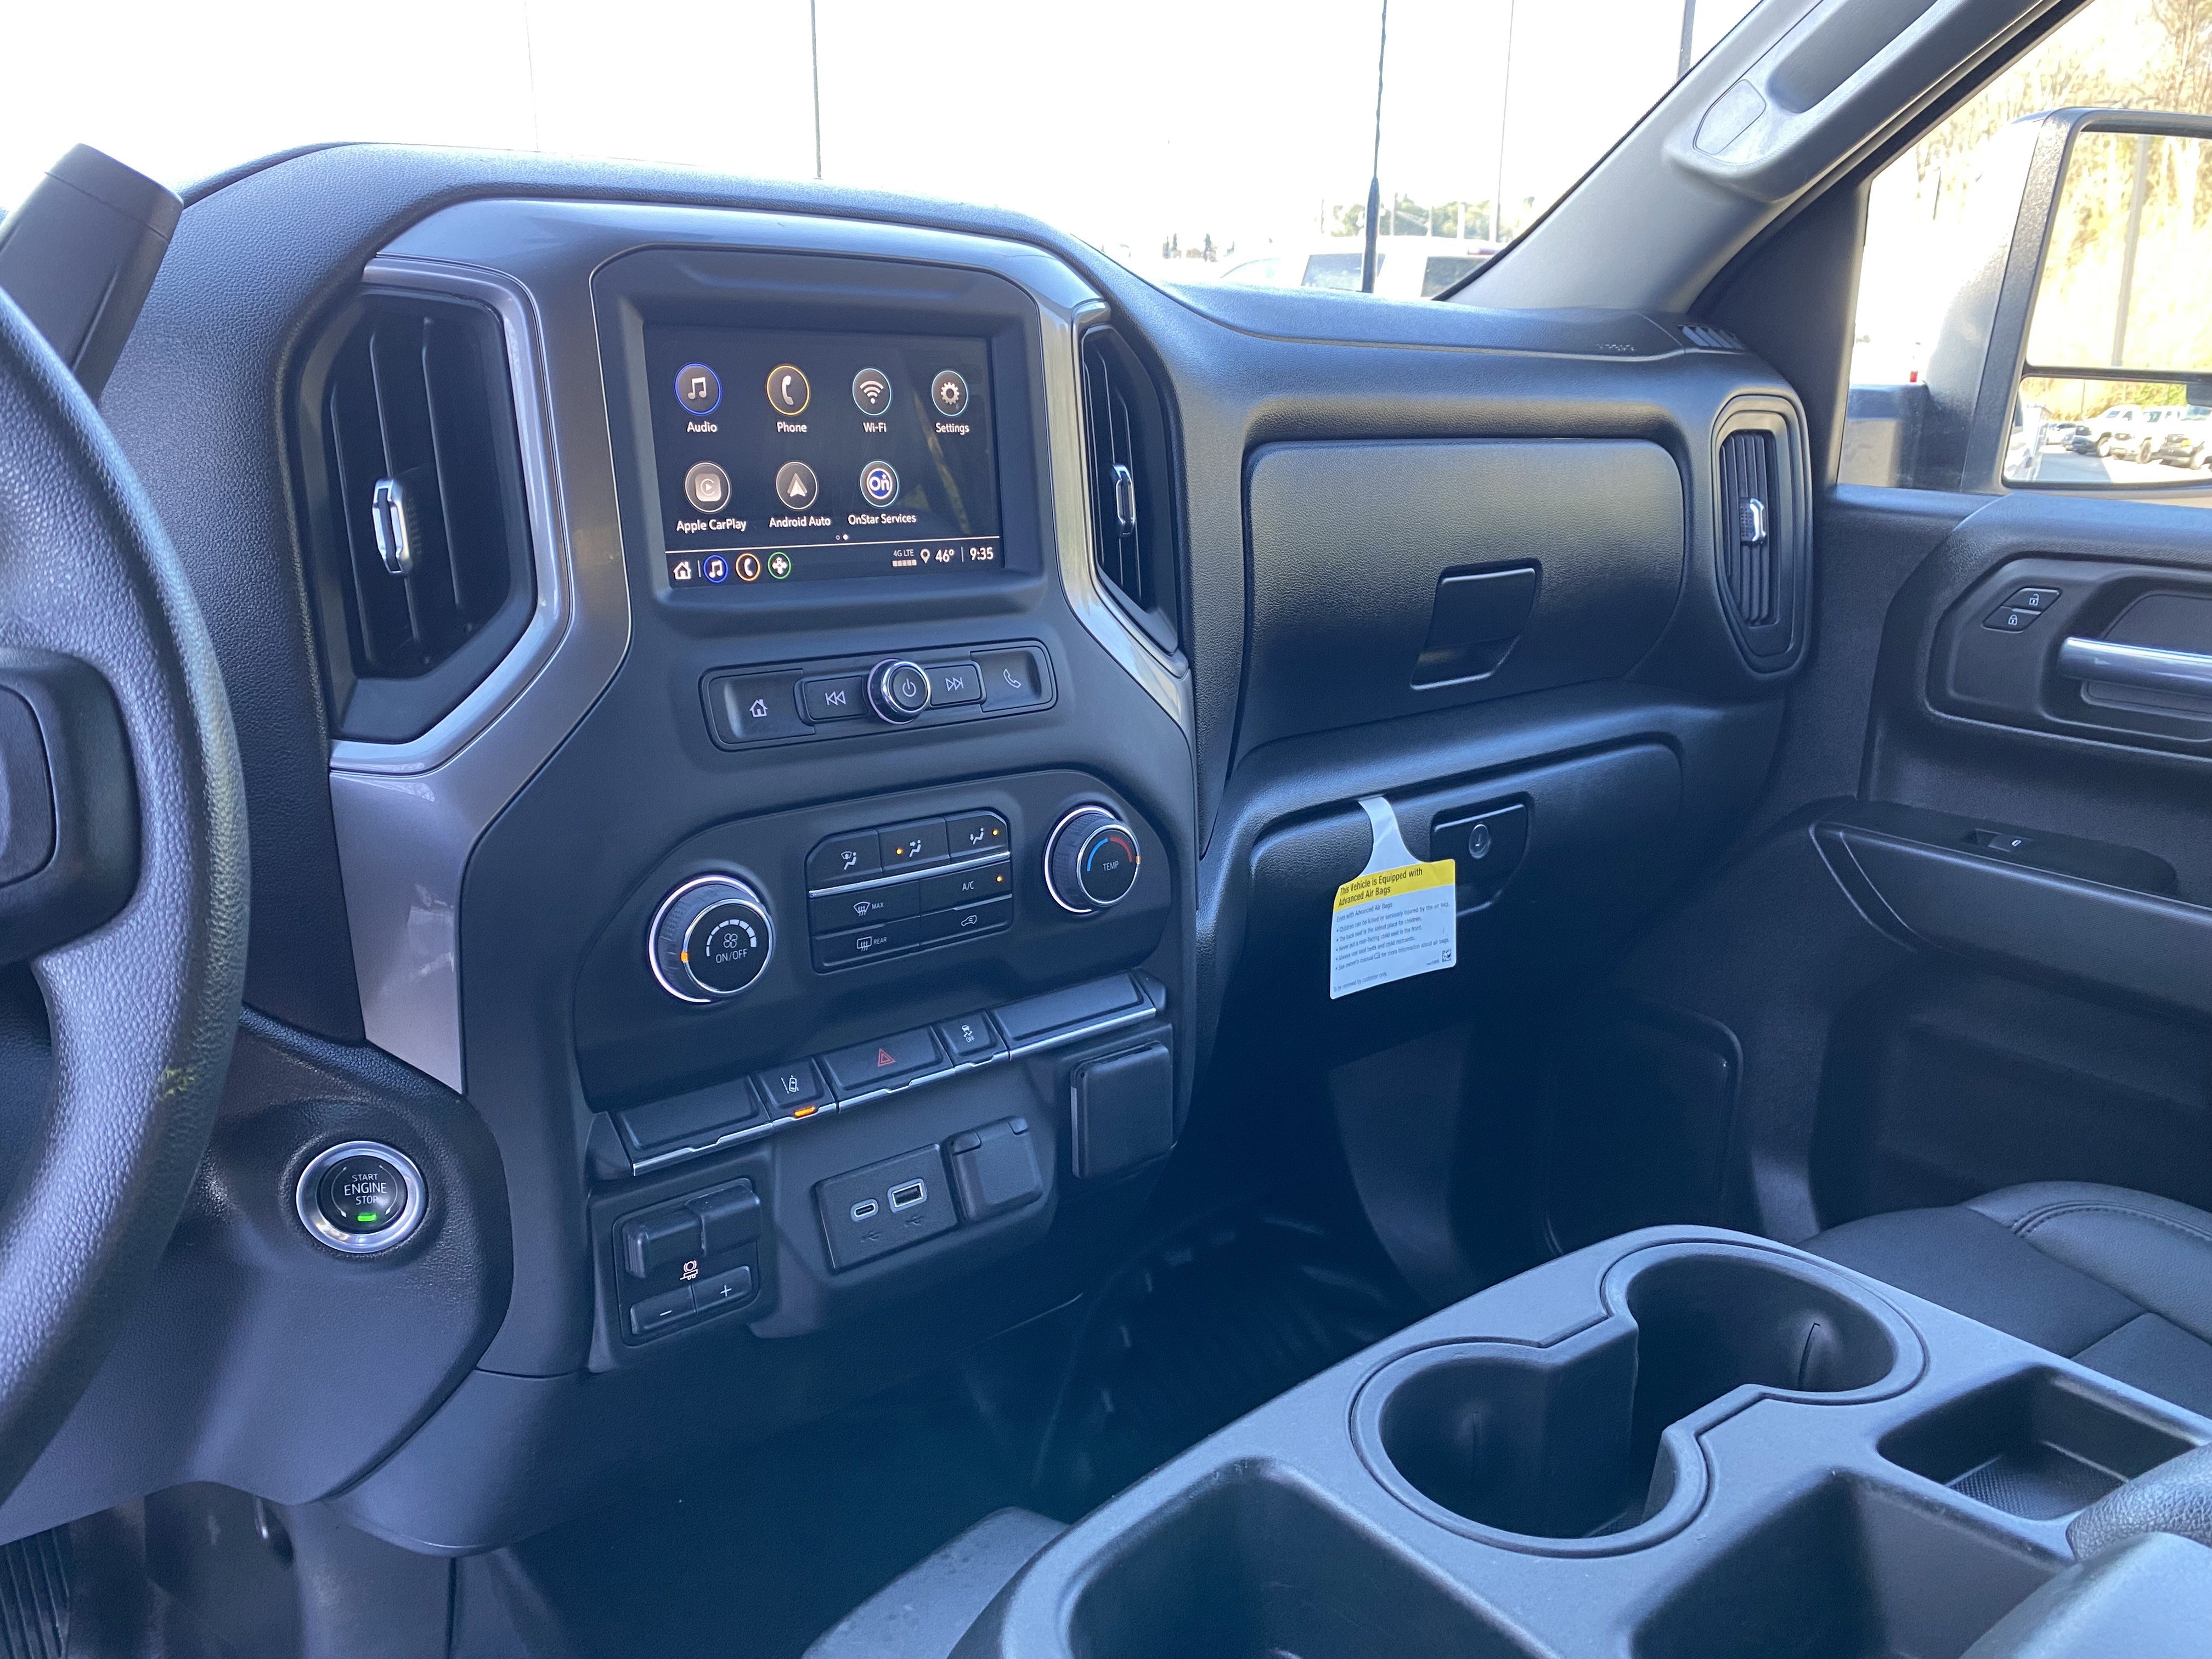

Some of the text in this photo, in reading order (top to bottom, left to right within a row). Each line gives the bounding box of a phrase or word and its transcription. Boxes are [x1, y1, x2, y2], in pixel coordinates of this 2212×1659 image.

[687, 421, 718, 432] Audio
[777, 421, 807, 432] Phone
[863, 422, 887, 432] Wi-Fi
[935, 422, 970, 435] Settings
[869, 476, 890, 491] On
[769, 516, 831, 528] Android Auto
[848, 513, 917, 525] OnStar Services
[676, 518, 746, 533] Apple CarPlay
[970, 547, 994, 561] 9:35
[1103, 861, 1119, 871] TEMP
[962, 881, 974, 891] A/C
[1340, 885, 1349, 895] This
[1351, 879, 1370, 891] Vehicle
[1379, 870, 1407, 884] Equipped
[1409, 868, 1422, 877] with
[1339, 887, 1391, 907] Advanced Air Bags
[715, 949, 747, 963] ON/OFF
[352, 1173, 378, 1182] START
[343, 1182, 387, 1196] ENGINE
